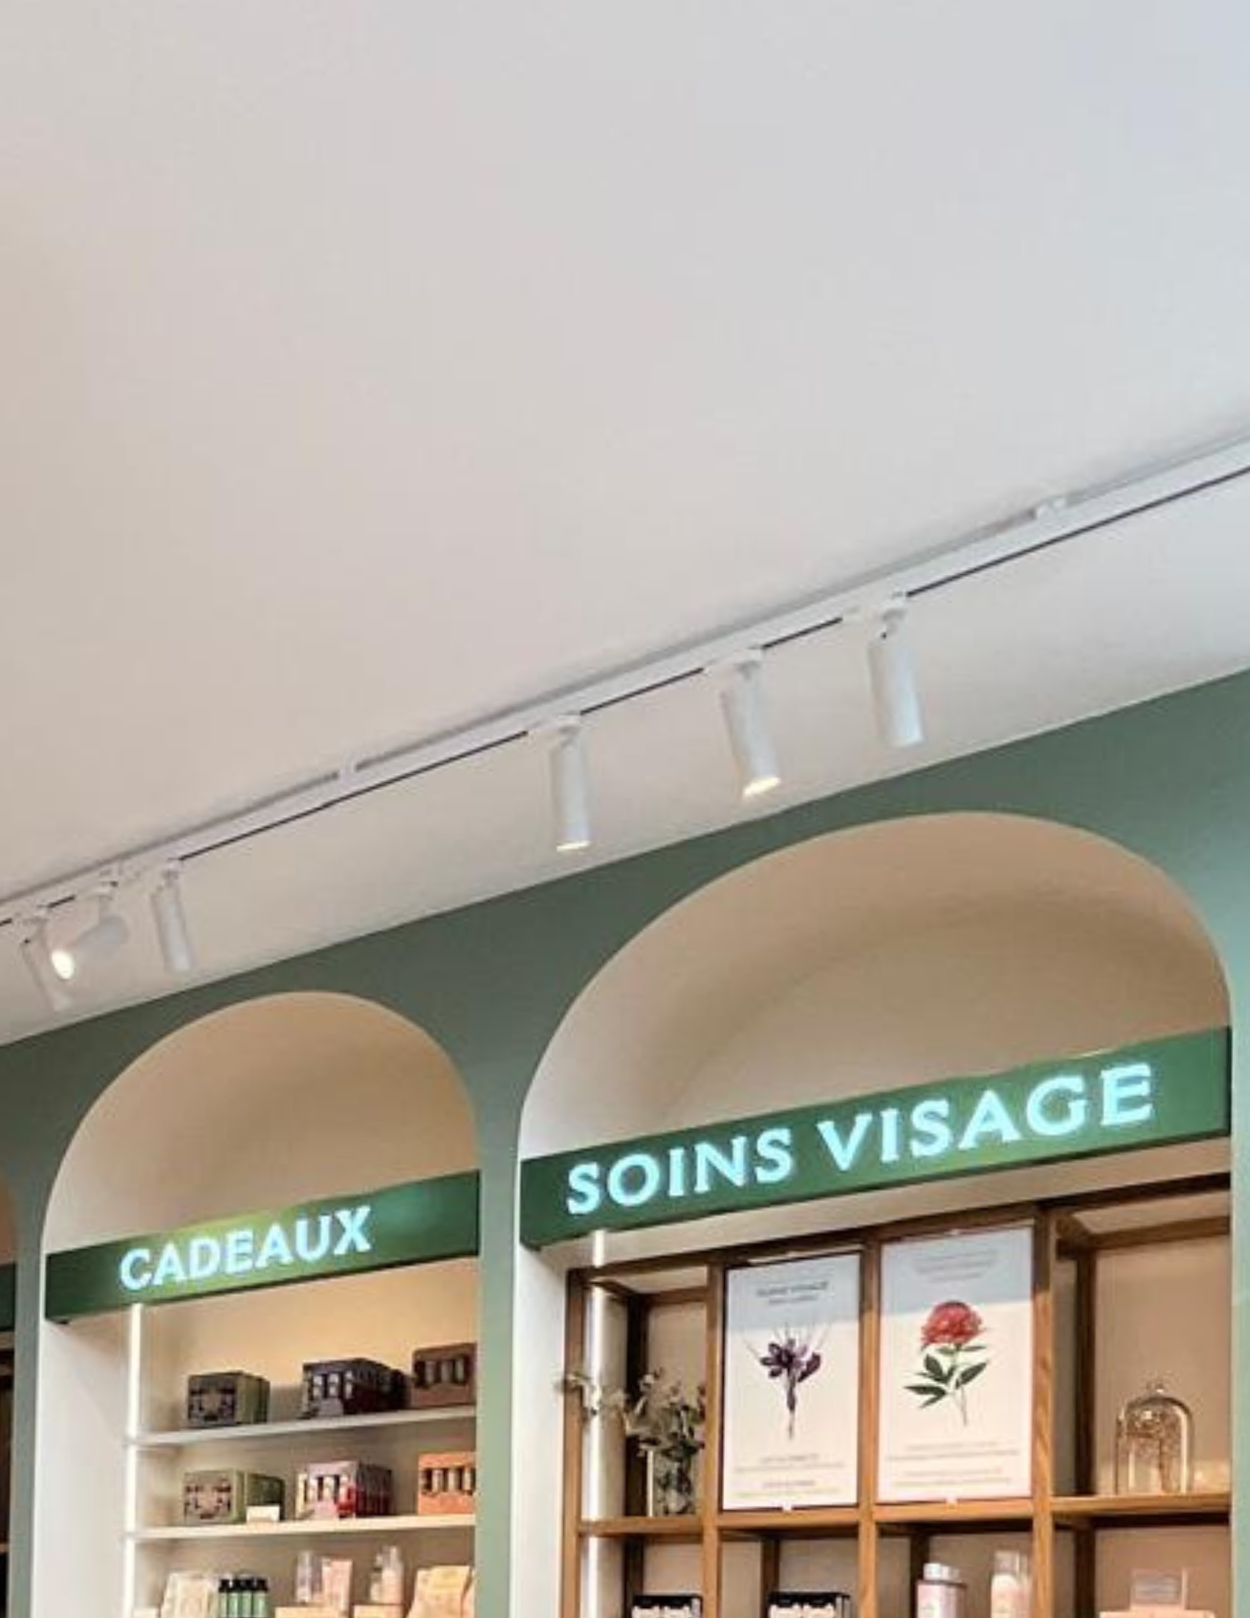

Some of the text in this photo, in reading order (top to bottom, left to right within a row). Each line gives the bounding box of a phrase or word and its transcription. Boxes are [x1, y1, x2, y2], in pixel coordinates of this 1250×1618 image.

[566, 1061, 1154, 1216] SOINS VISAGE
[118, 1204, 372, 1291] CADEAUX
